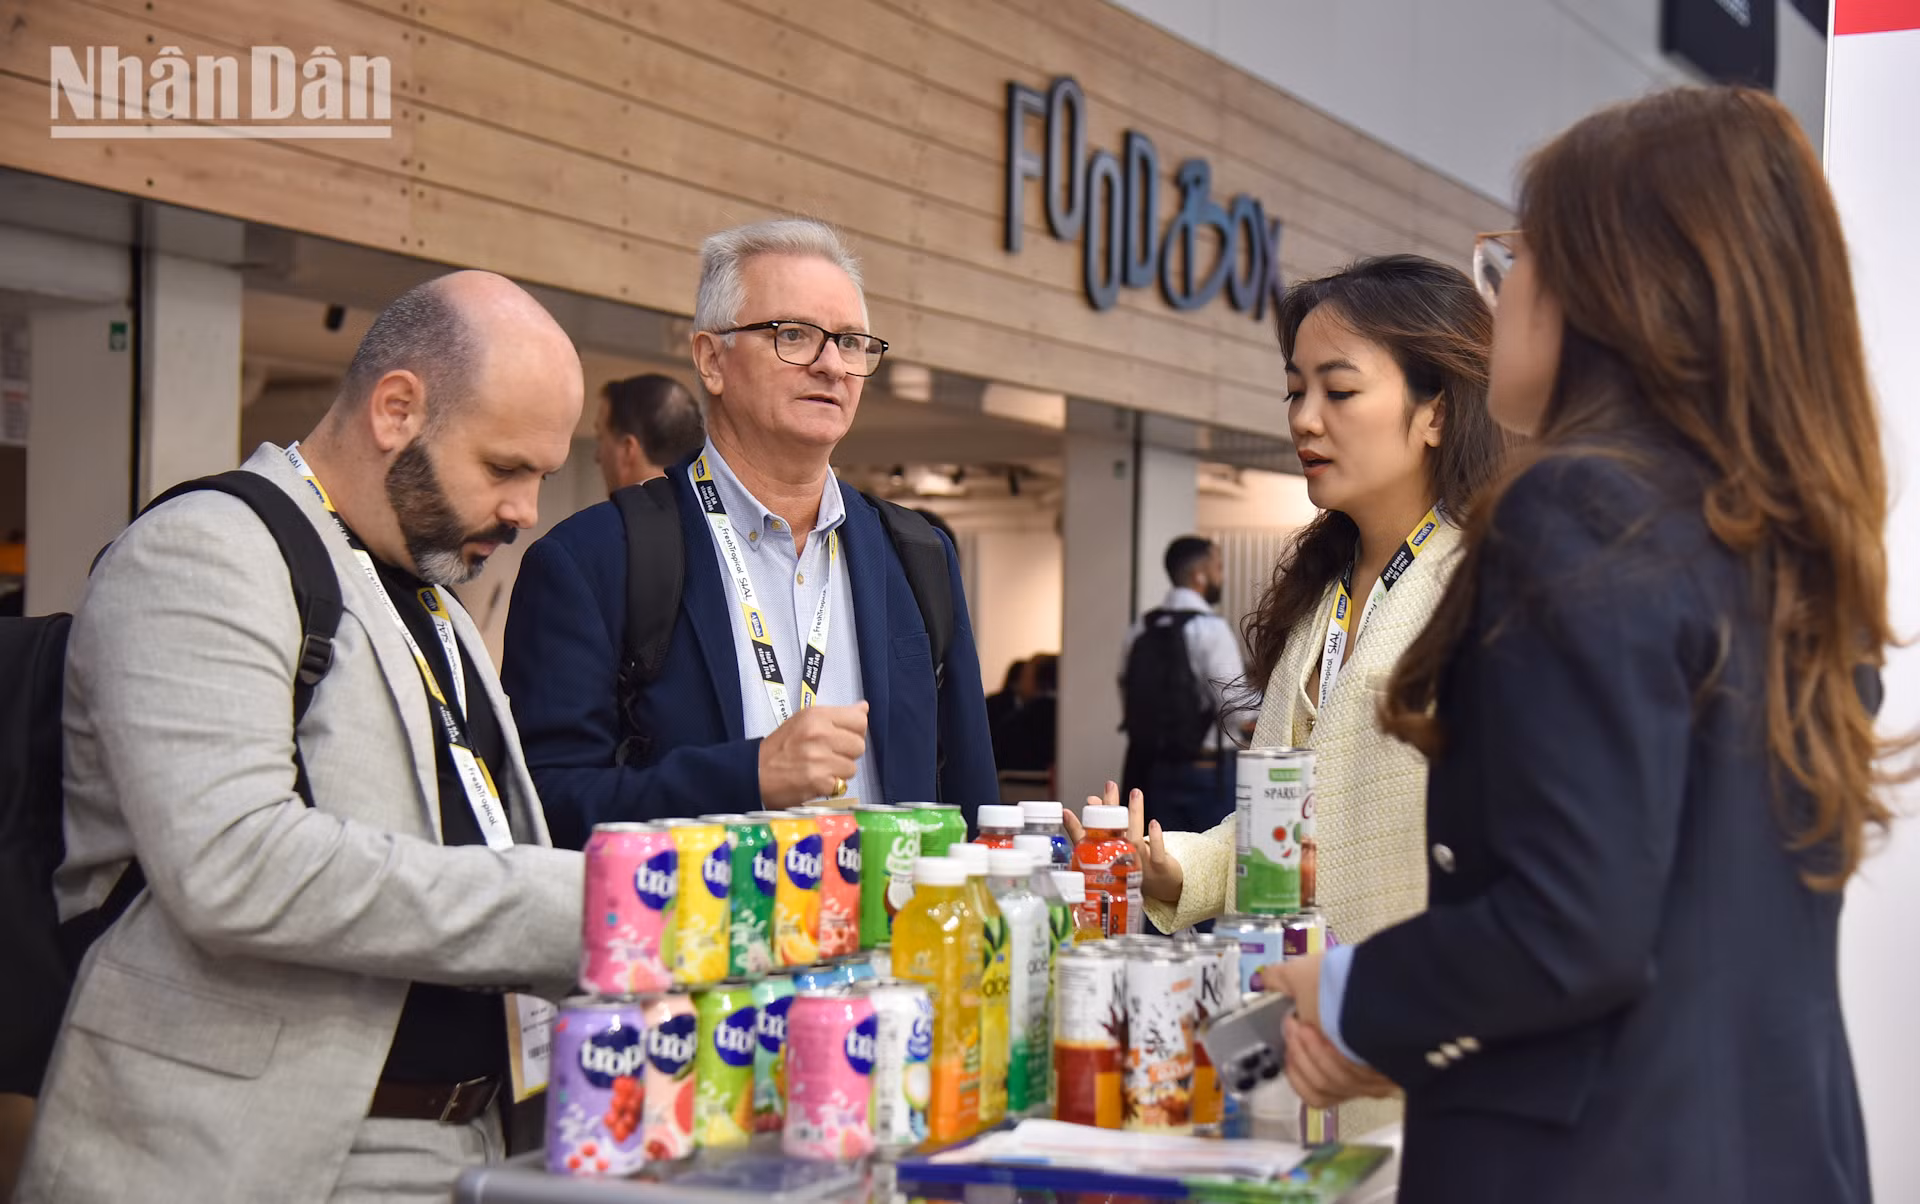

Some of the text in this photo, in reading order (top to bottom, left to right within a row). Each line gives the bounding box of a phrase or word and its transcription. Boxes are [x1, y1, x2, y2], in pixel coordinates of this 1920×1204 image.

[700, 486, 710, 501] stand
[721, 528, 744, 574] FreshTropical
[1392, 551, 1406, 569] stand
[1398, 558, 1409, 573] Hall
[740, 578, 753, 600] SIAL
[1328, 631, 1341, 654] SIAL
[758, 648, 768, 665] stand
[765, 651, 774, 665] Hall
[1320, 658, 1333, 709] FreshTropical
[468, 767, 498, 826] FreshTropical
